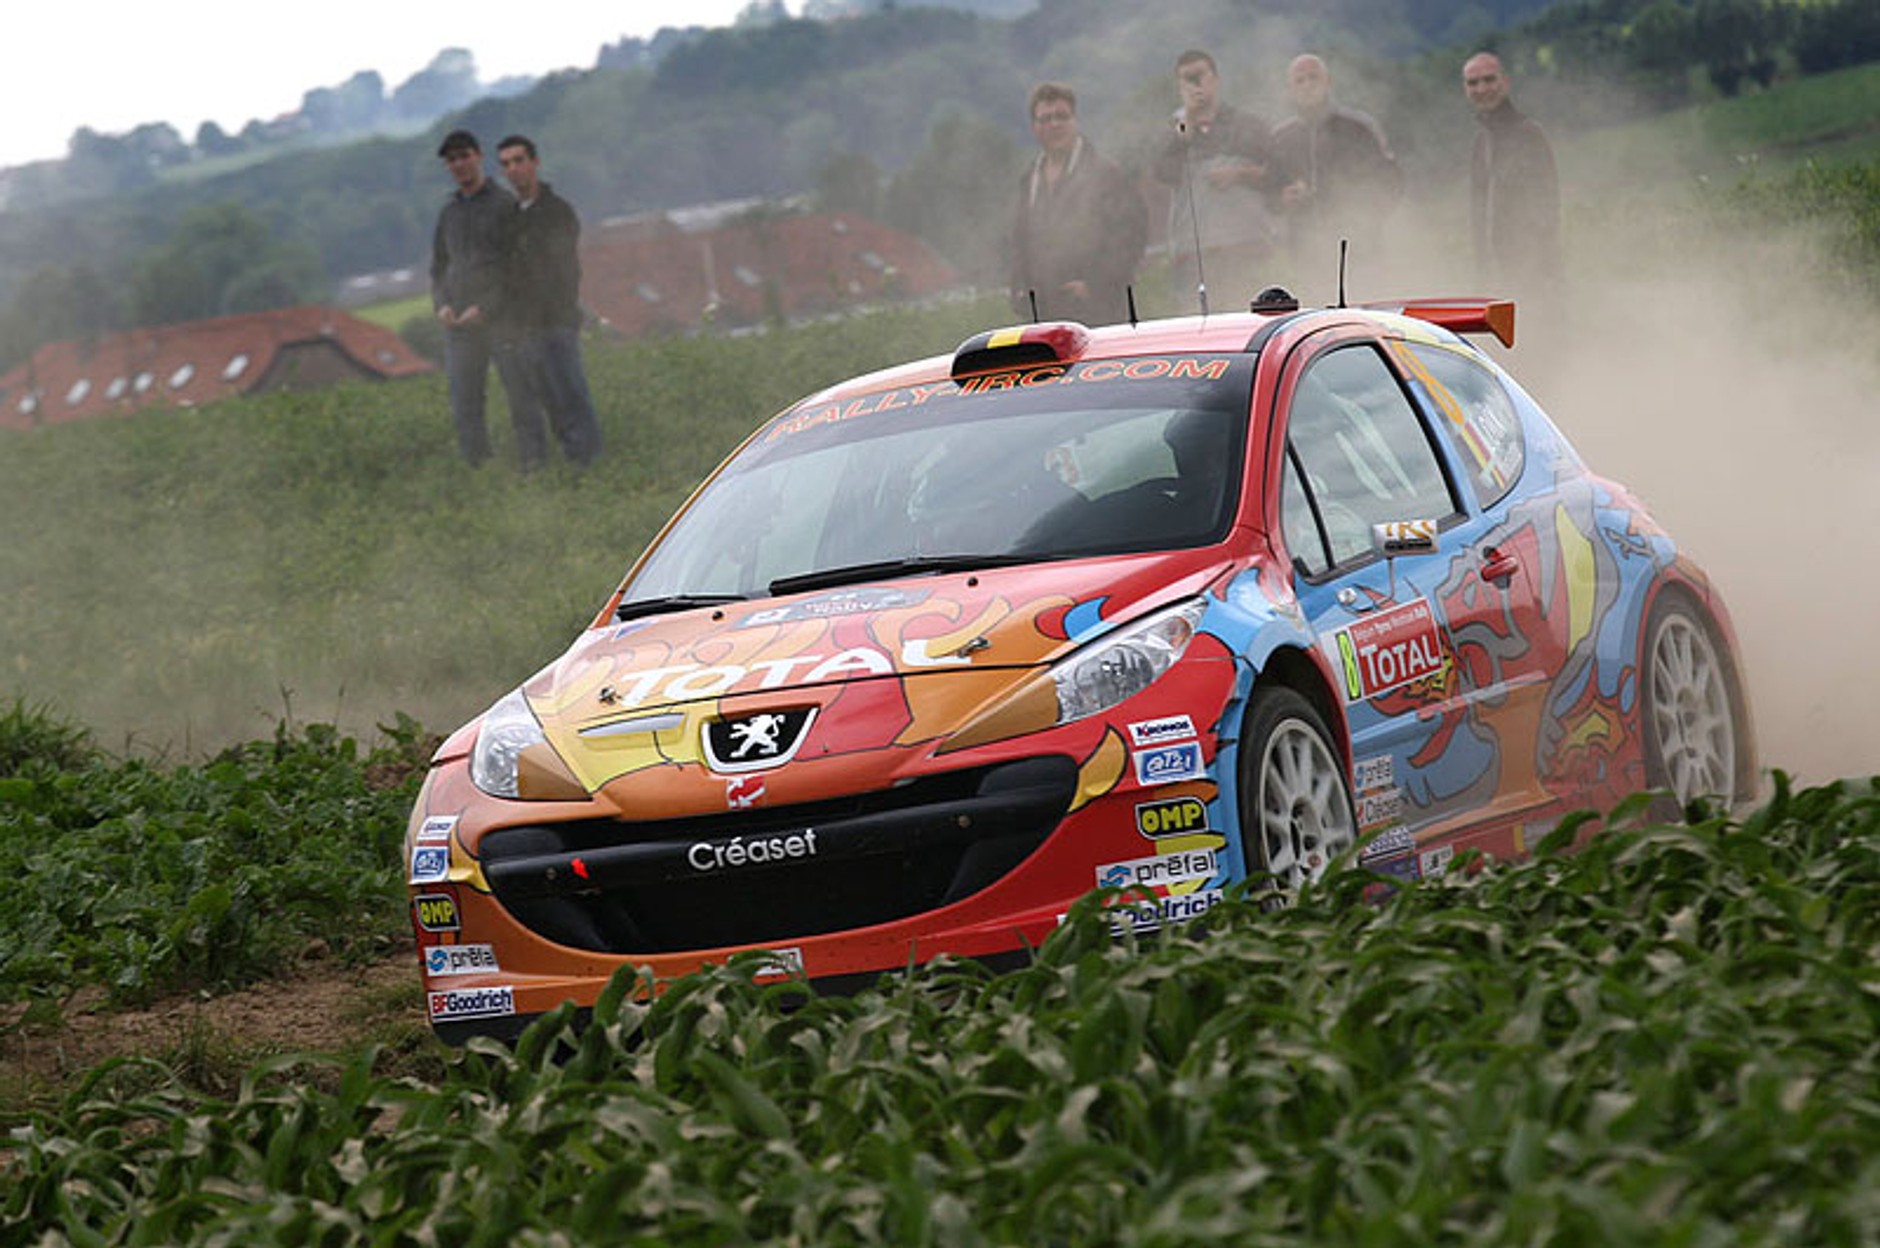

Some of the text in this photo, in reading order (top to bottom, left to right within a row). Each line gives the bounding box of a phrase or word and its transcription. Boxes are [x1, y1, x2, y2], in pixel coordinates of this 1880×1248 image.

[766, 358, 1230, 440] RALLY-IRC.COM
[611, 638, 972, 707] TOTAL
[1359, 634, 1441, 687] TOTAL
[1141, 802, 1202, 833] OMP
[688, 828, 817, 870] Créaset
[419, 900, 454, 924] OMP
[432, 989, 512, 1014] BFGoodrich
